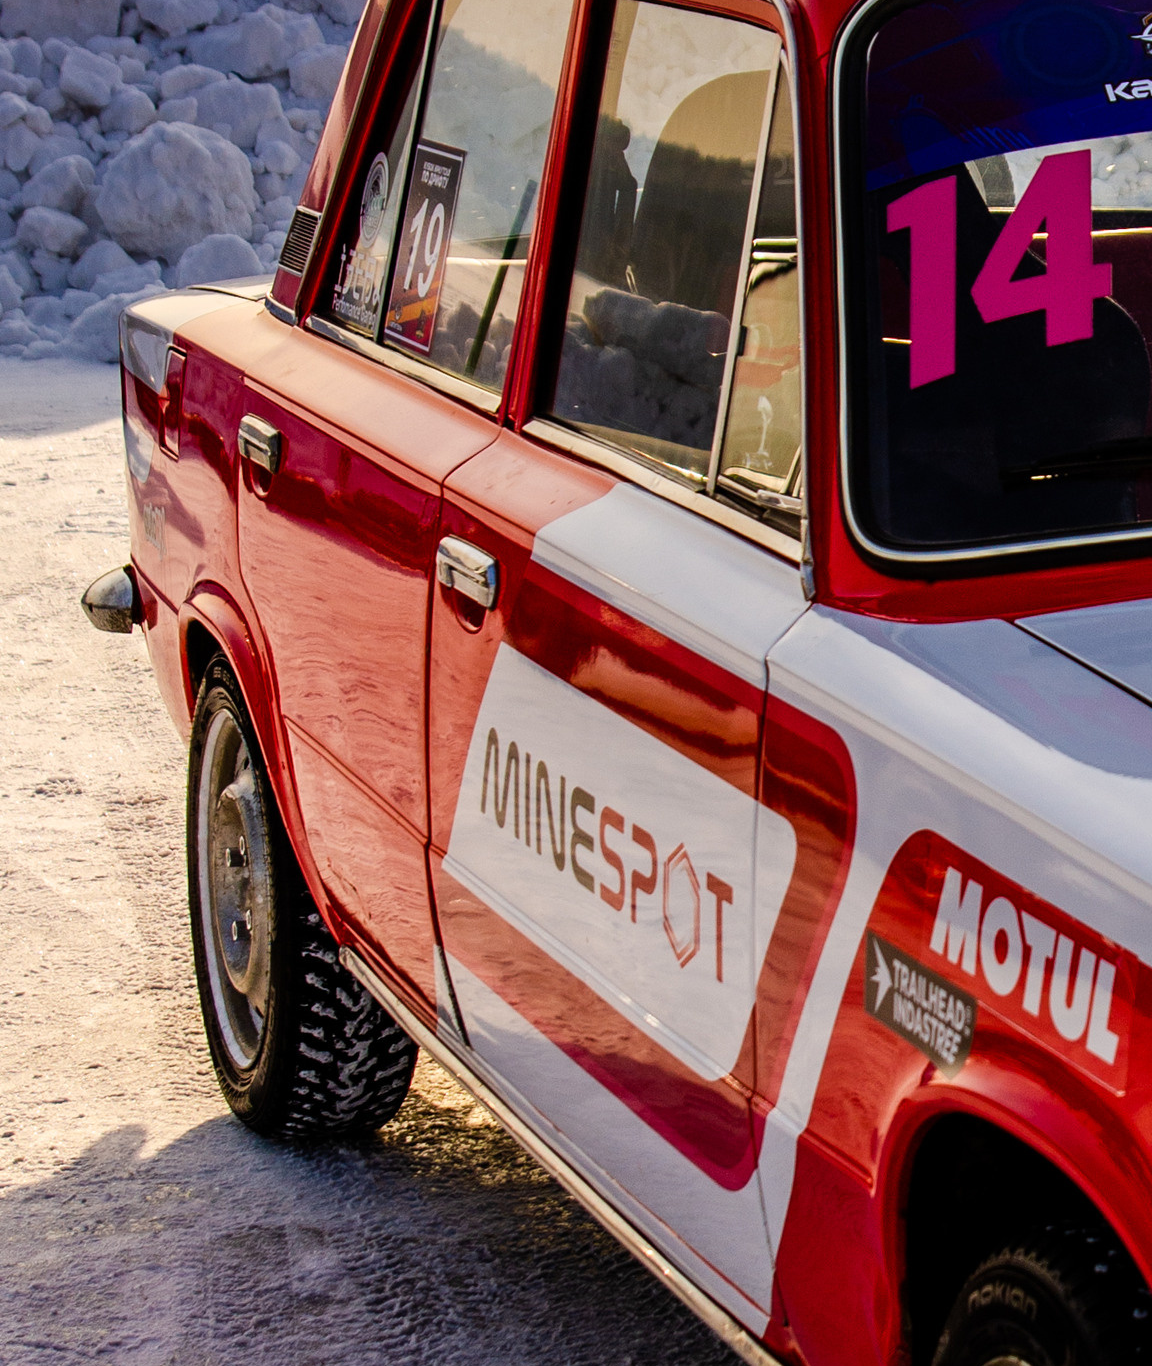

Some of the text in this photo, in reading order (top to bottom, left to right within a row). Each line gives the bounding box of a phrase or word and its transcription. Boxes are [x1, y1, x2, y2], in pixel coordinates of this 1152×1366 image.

[403, 198, 445, 298] 19
[887, 148, 1113, 390] 14
[480, 727, 734, 983] MINESPOT
[892, 958, 966, 1031] TRAILHEAD
[892, 992, 962, 1065] INDASTREE
[929, 866, 1126, 1066] MOTUL
